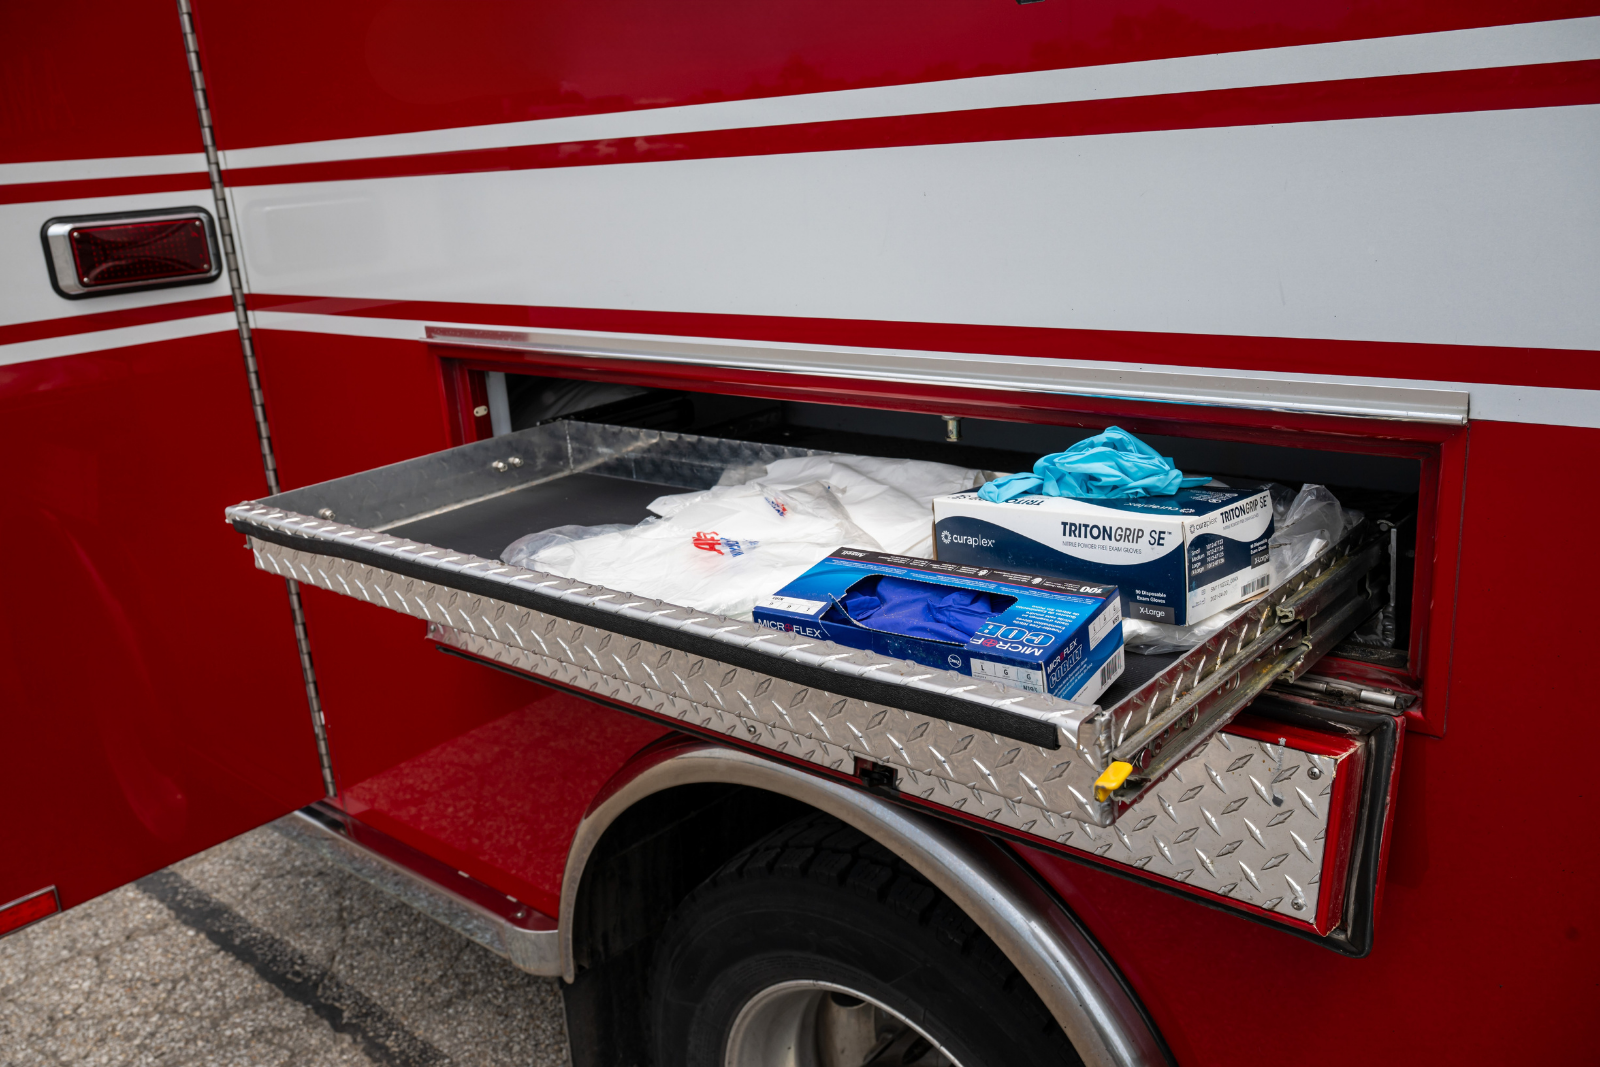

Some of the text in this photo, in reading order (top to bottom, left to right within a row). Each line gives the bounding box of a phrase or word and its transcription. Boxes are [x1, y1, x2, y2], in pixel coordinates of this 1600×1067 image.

[1219, 498, 1259, 524] TRITONGRIP
[1195, 517, 1218, 531] curaplex
[1060, 521, 1145, 544] TRITONGRIP
[952, 533, 994, 548] curaplex
[1077, 542, 1097, 550] POWDER
[1139, 606, 1166, 618] X-Large
